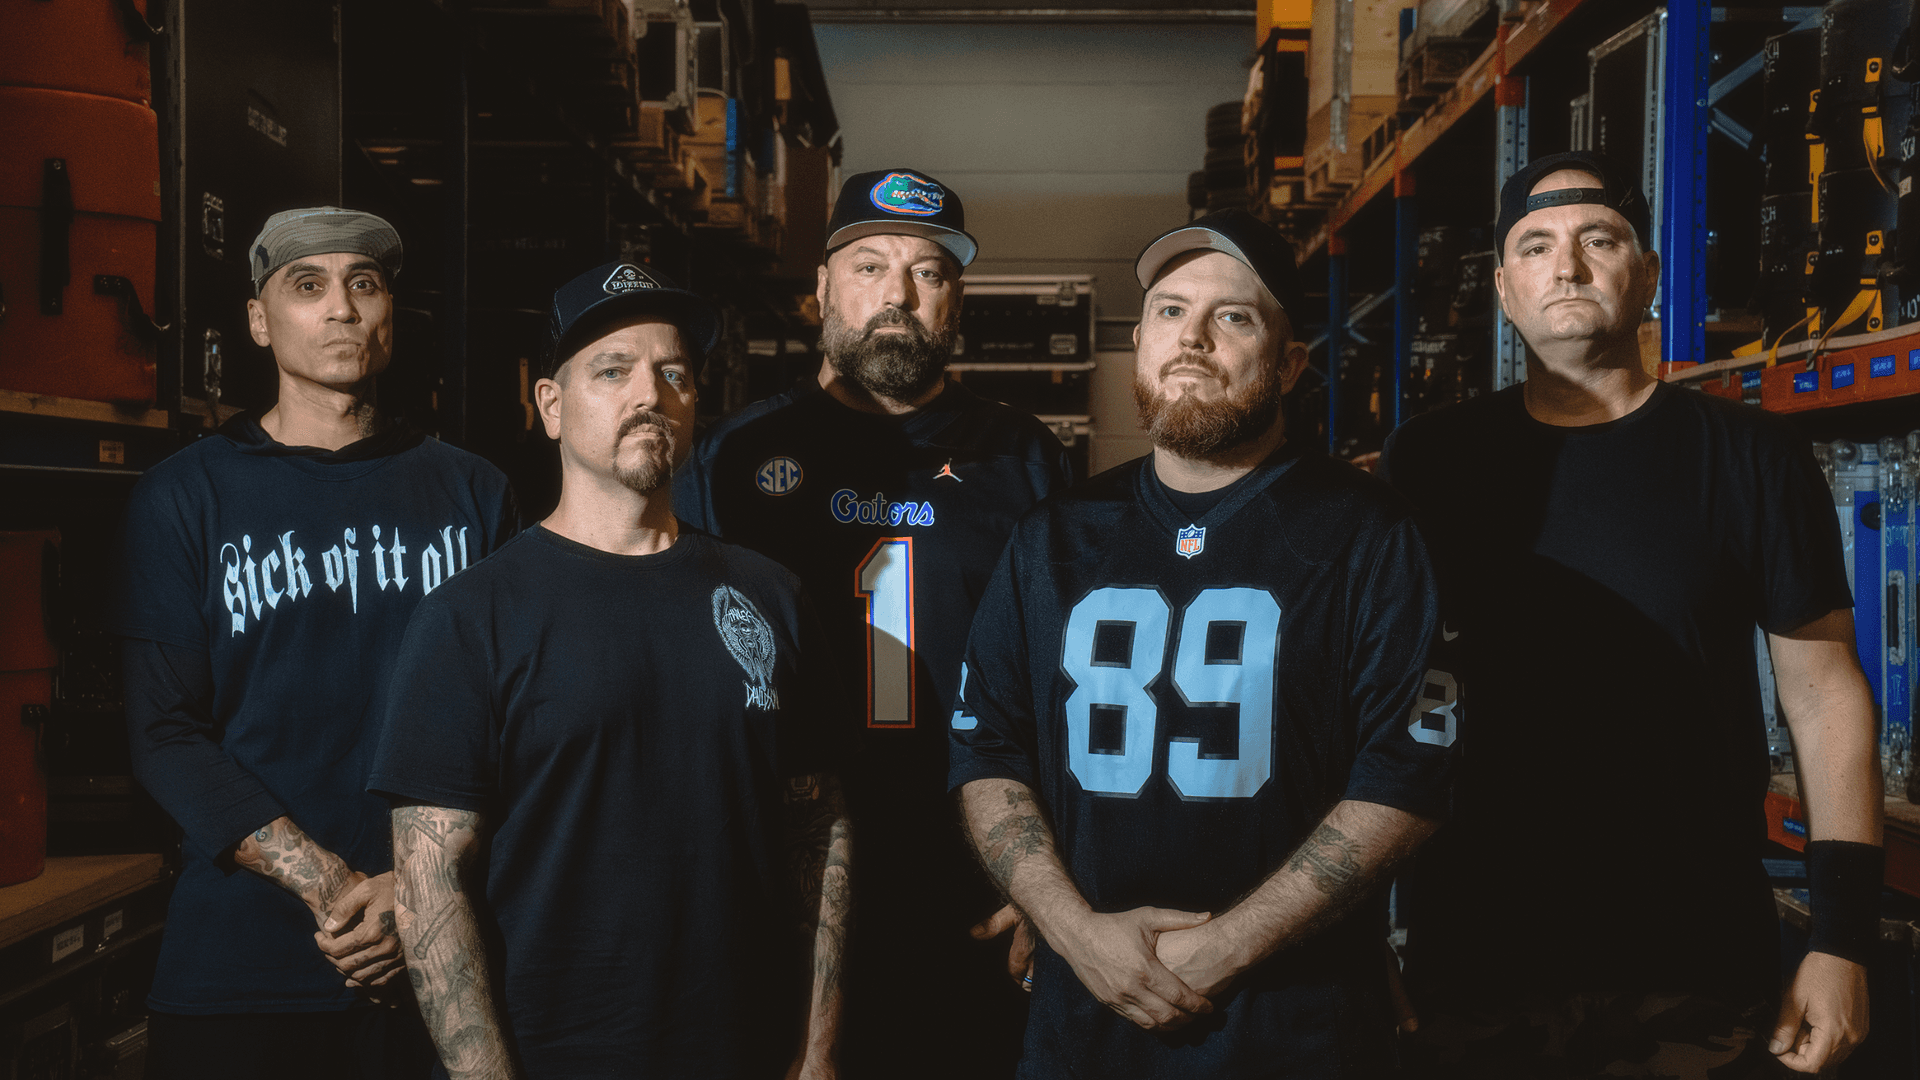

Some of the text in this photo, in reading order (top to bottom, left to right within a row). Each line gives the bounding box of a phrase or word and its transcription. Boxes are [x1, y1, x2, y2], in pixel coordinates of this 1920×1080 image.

[758, 456, 799, 493] SEC
[831, 488, 935, 527] Gators
[220, 524, 467, 638] Sick of it all
[1180, 539, 1200, 552] NFL
[854, 536, 915, 729] 1
[1059, 583, 1283, 801] 89
[1408, 667, 1464, 753] 8
